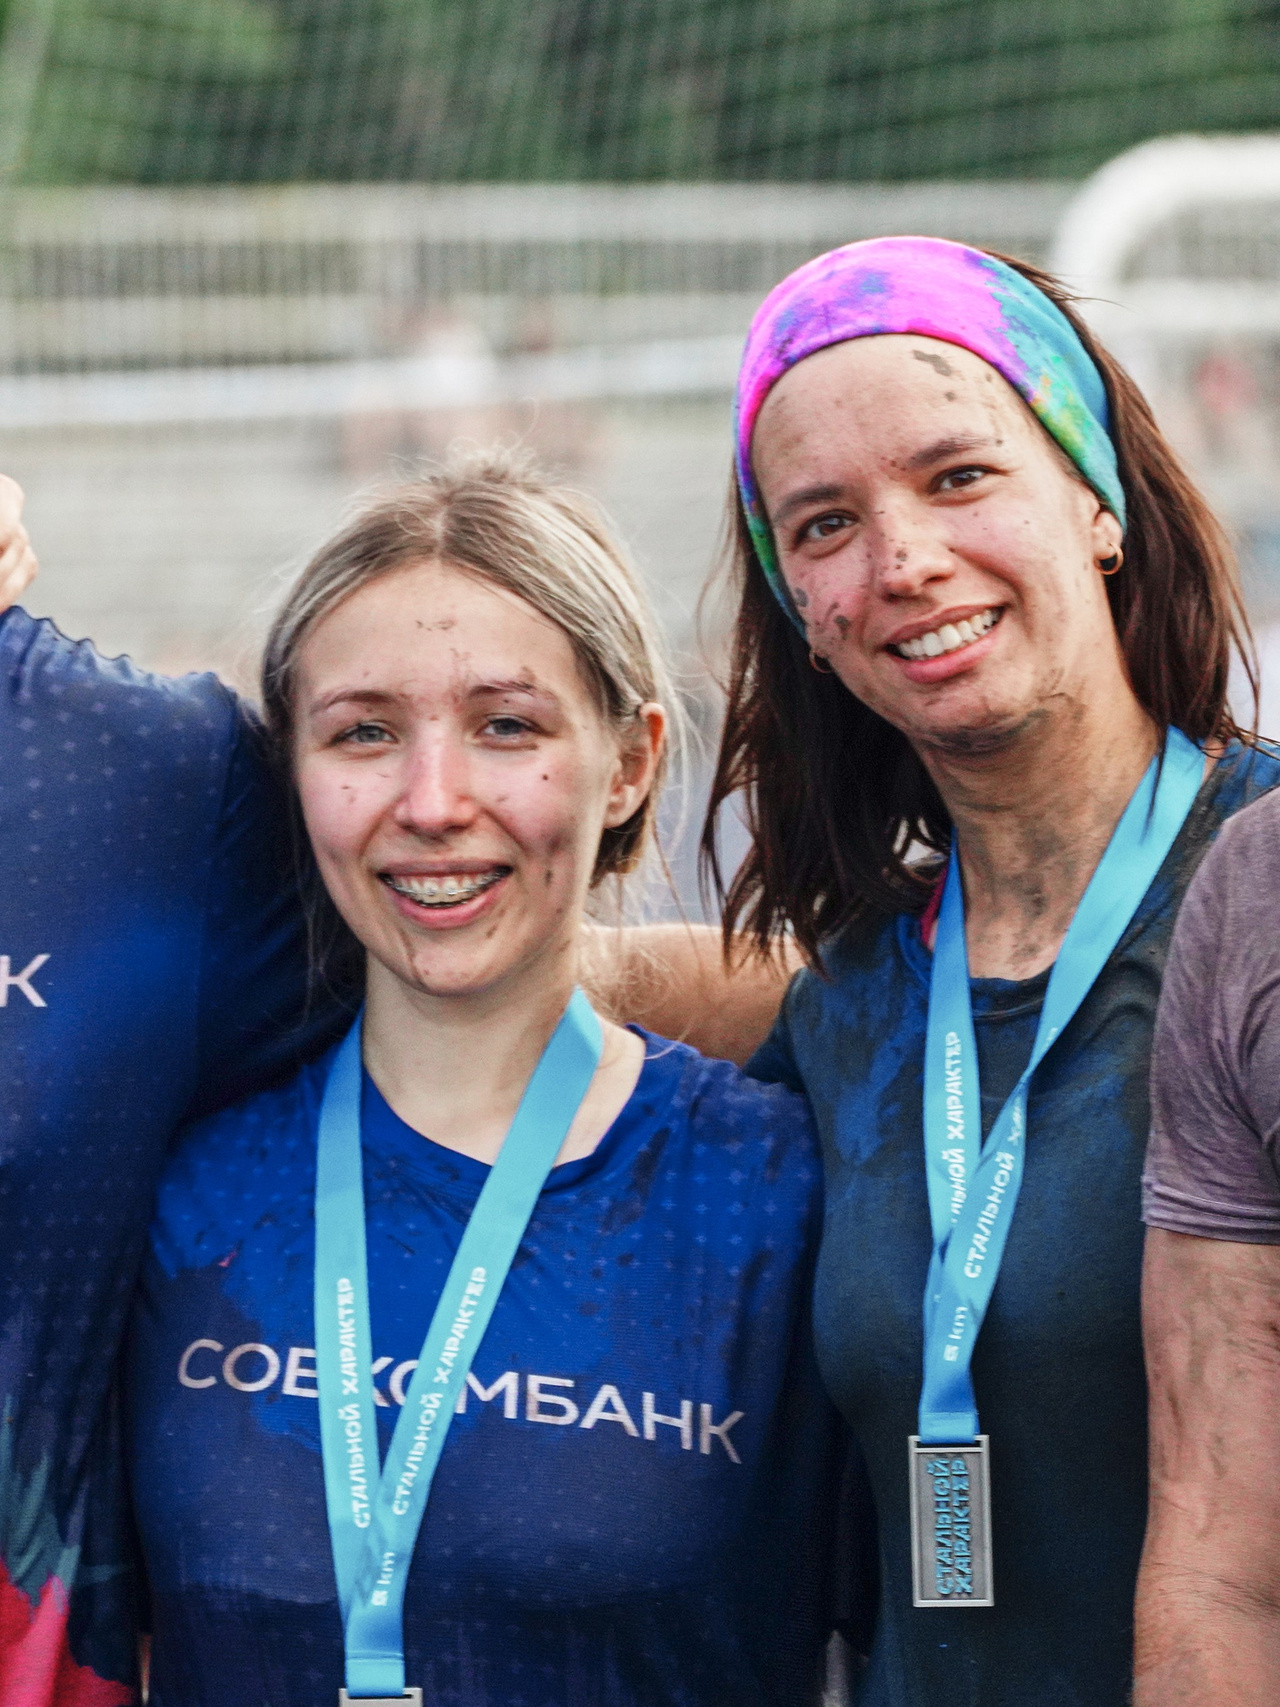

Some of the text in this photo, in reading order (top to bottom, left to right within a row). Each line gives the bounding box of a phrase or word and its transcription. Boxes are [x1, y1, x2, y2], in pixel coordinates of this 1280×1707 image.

[941, 1031, 967, 1223] ЛЬНОЙ ХАРАКТЕР
[963, 1151, 1015, 1278] СТАЛЬНОЙ
[392, 1266, 487, 1515] СТАЛЬНОЙ ХАРАКТЕР
[948, 1306, 968, 1340] km
[337, 1277, 370, 1529] СТАЛЬНОЙ ХАРАКТЕР
[926, 1458, 954, 1595] СТАЛЬНОЙ
[951, 1459, 973, 1594] ХАРАКТЕР
